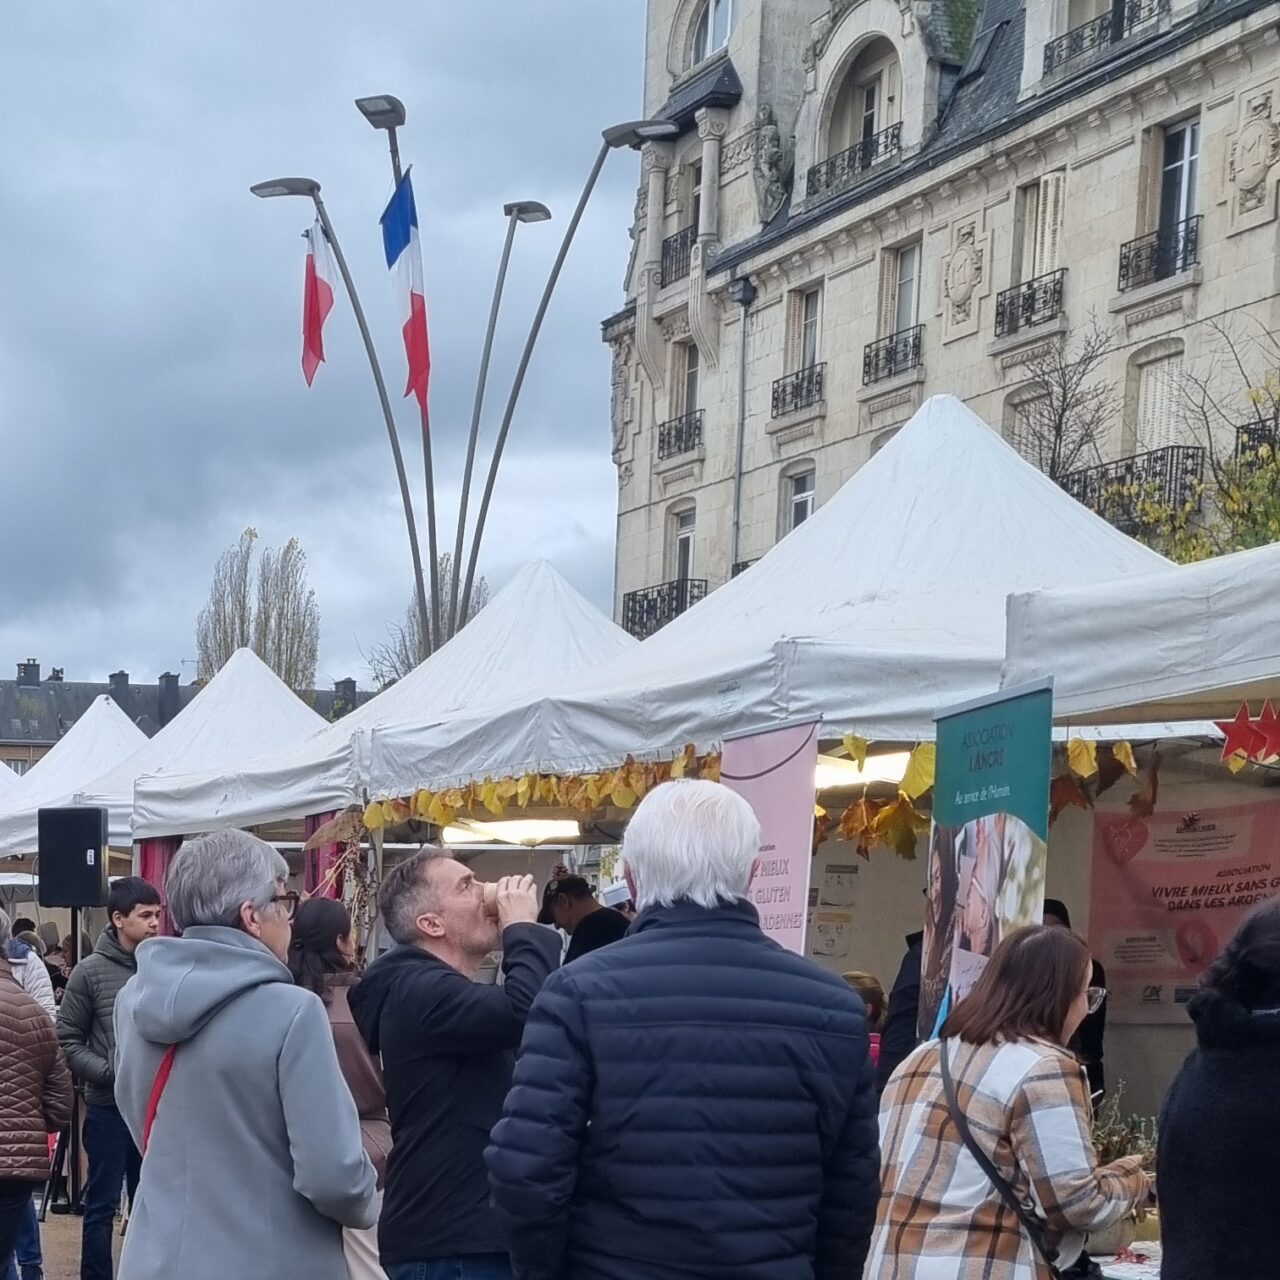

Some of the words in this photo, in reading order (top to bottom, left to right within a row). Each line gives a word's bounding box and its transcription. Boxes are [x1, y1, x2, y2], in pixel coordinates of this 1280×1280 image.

[962, 720, 1014, 750] ASSOCIATION
[1216, 863, 1271, 878] ASSOCIATION
[755, 886, 792, 904] GLUTEN
[1152, 886, 1188, 898] VIVRE
[1191, 882, 1233, 897] MIEUX
[1235, 878, 1268, 894] SANS
[1168, 899, 1201, 912] DANS
[1204, 897, 1226, 909] LES
